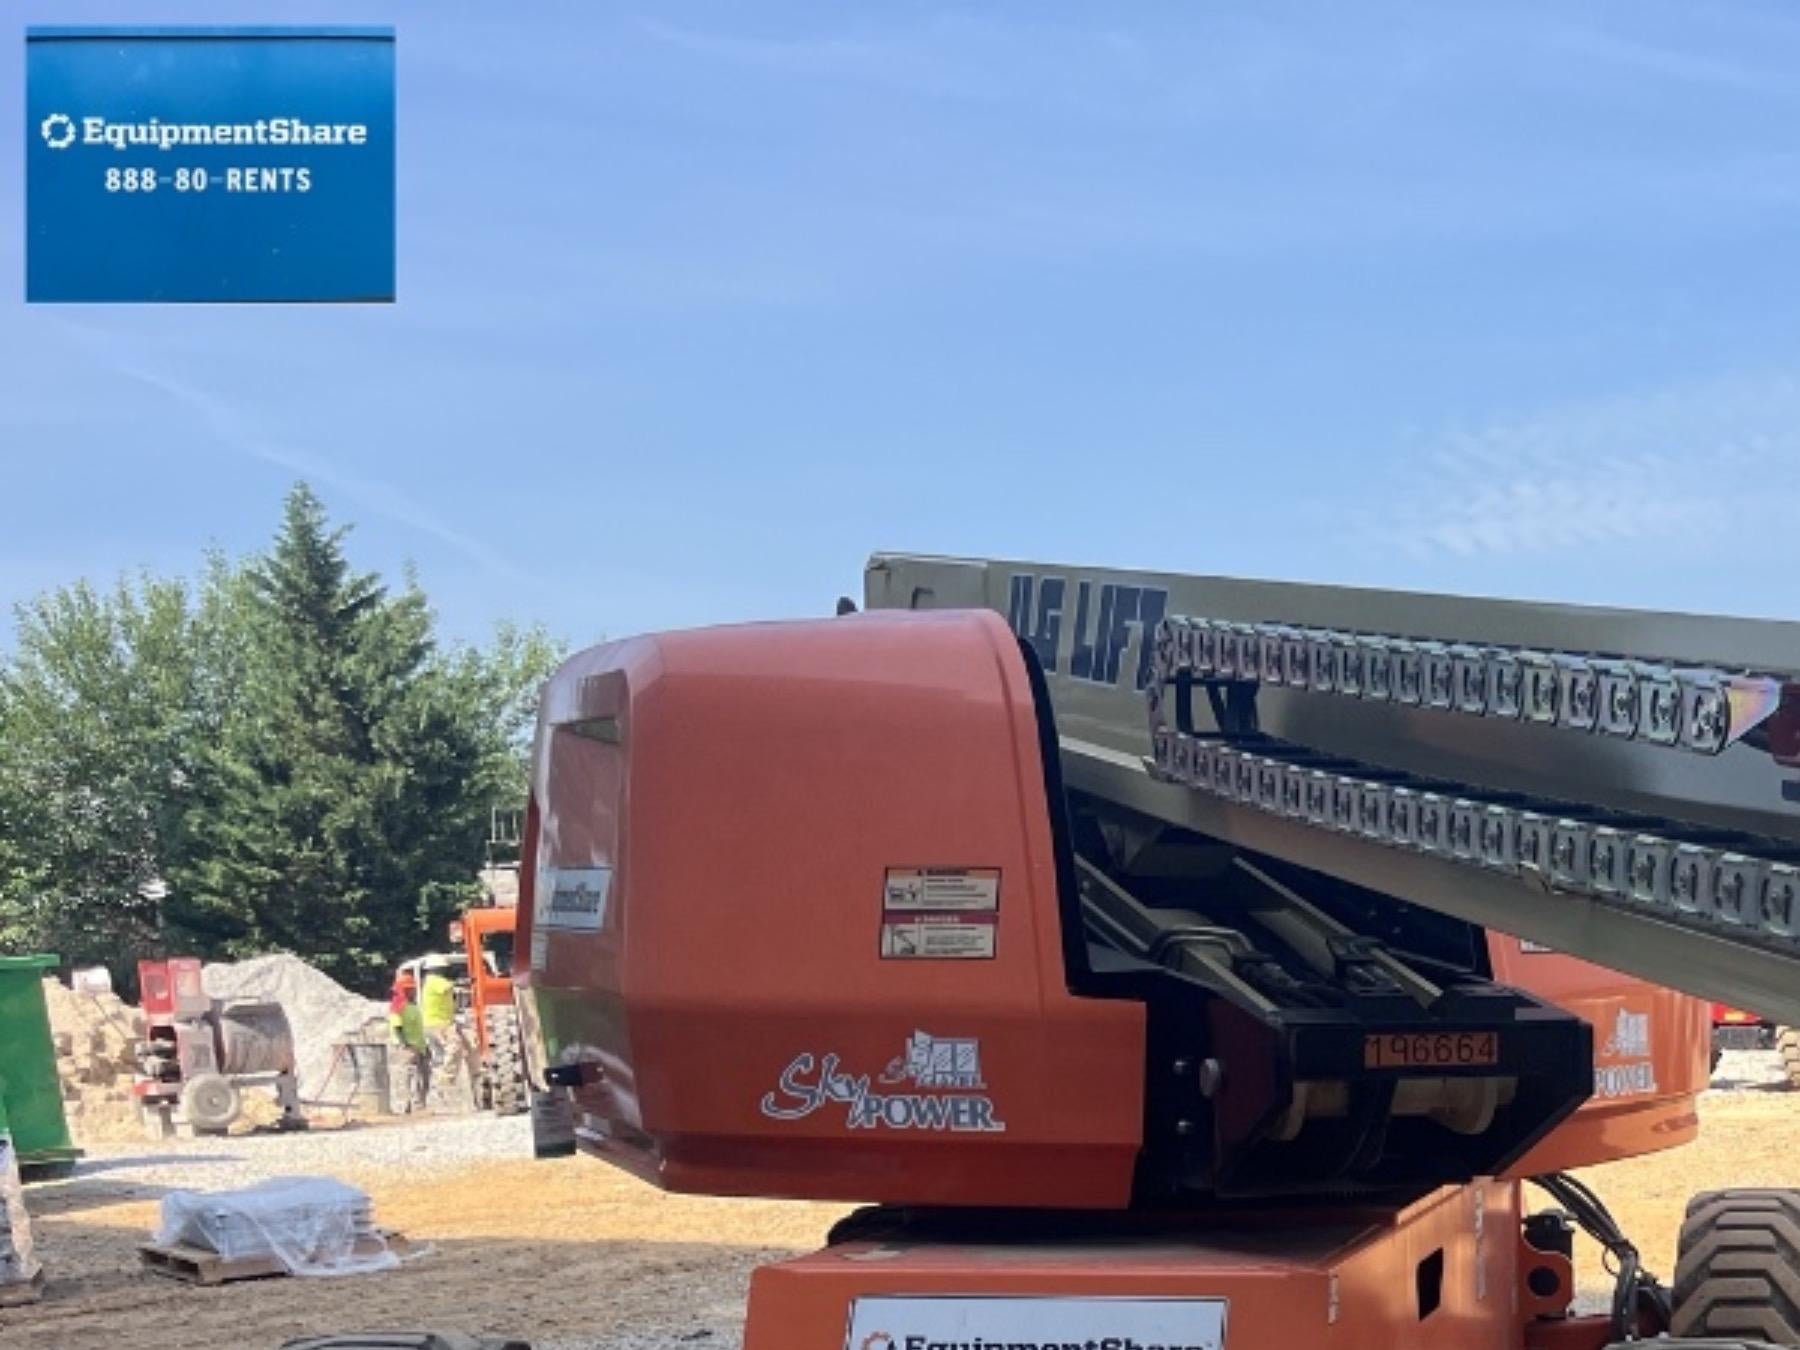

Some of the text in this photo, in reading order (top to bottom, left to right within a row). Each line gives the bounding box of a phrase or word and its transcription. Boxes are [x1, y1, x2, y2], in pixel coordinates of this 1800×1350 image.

[1070, 581, 1168, 690] LIFT
[1369, 1034, 1494, 1066] 196664
[761, 1052, 870, 1129] Sky
[858, 1095, 996, 1131] POWER
